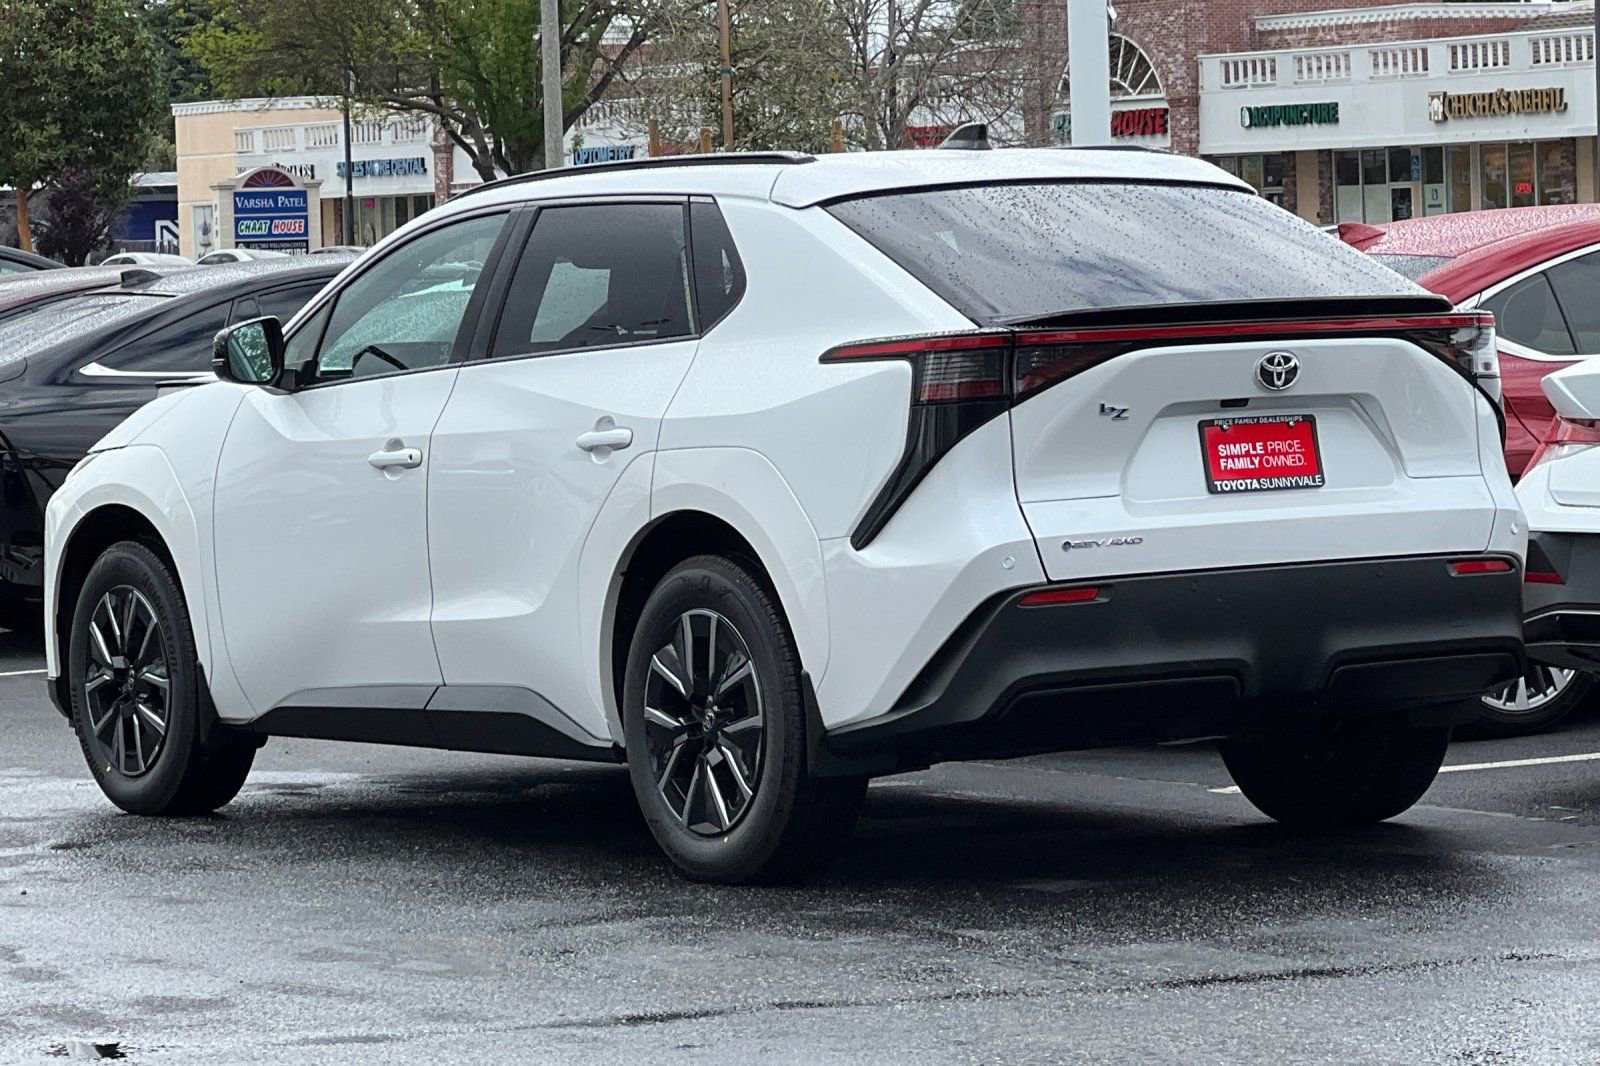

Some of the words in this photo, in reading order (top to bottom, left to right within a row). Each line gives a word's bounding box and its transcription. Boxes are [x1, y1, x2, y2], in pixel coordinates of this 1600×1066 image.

[1510, 87, 1567, 114] MEHFIL
[1111, 108, 1169, 137] HOUSE
[1252, 102, 1339, 127] ACUPUNCTURE
[574, 146, 634, 165] OPTOMETRY
[391, 157, 426, 175] DENTAL
[235, 197, 274, 208] VARSHA
[278, 195, 306, 207] PATEL
[238, 220, 270, 235] CHAAT
[272, 219, 304, 234] HOUSE
[1214, 418, 1233, 426] PRICE
[1234, 417, 1259, 425] FAMILY
[1259, 415, 1303, 424] DEALERSHIPS
[1218, 442, 1265, 456] SIMPLE
[1267, 439, 1305, 454] PRICE.
[1219, 456, 1260, 471] FAMILY
[1262, 453, 1307, 468] OWNED.
[1214, 479, 1260, 491] TOYOTA
[1260, 474, 1323, 489] SUNNYVALE
